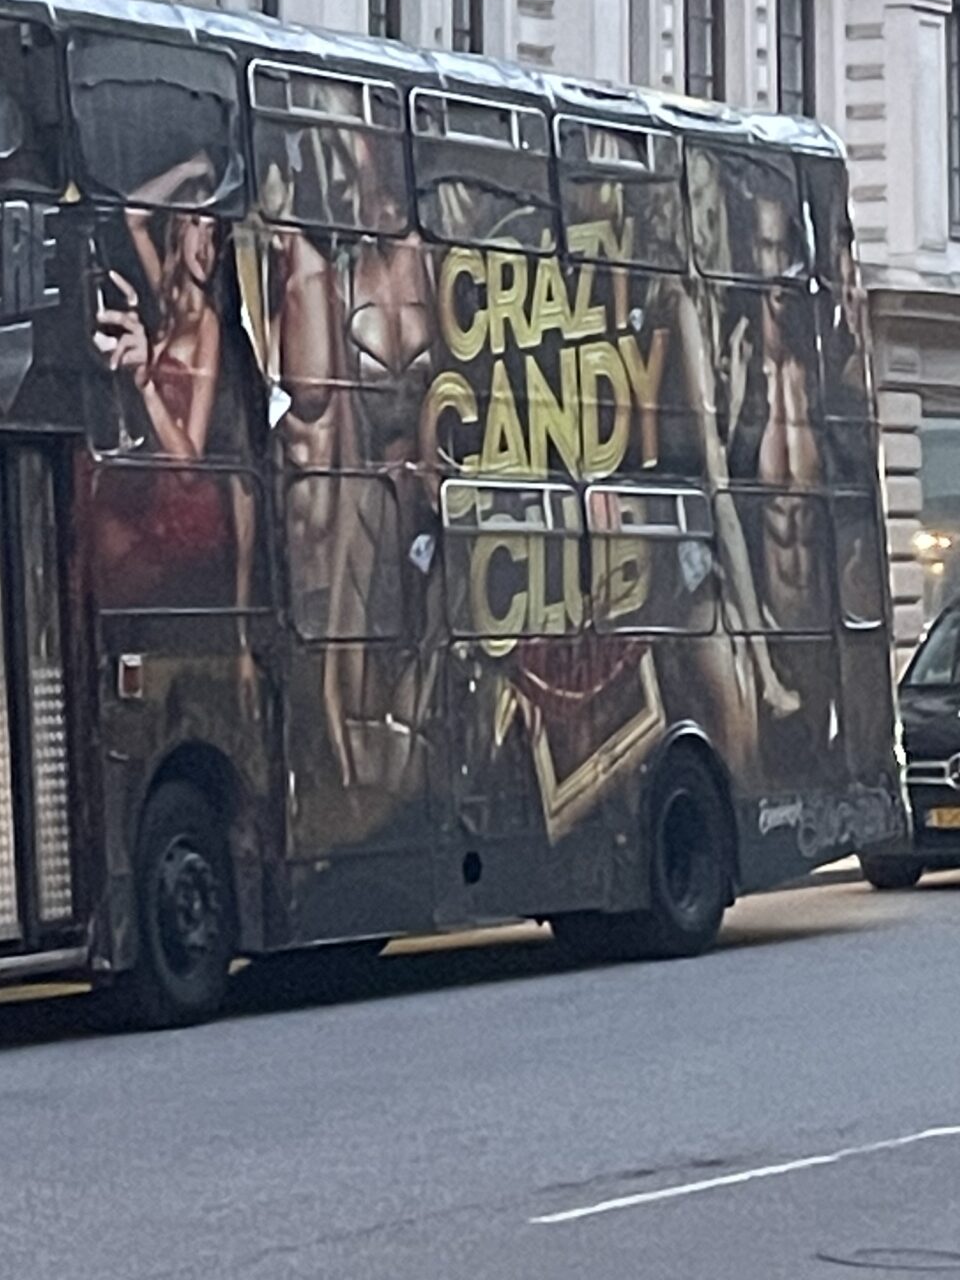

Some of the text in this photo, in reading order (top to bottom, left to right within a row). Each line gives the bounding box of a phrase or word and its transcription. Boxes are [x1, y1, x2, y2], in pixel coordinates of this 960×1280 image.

[442, 217, 634, 361] CRAZY
[419, 327, 670, 518] CANDY
[470, 493, 650, 658] CLUB
